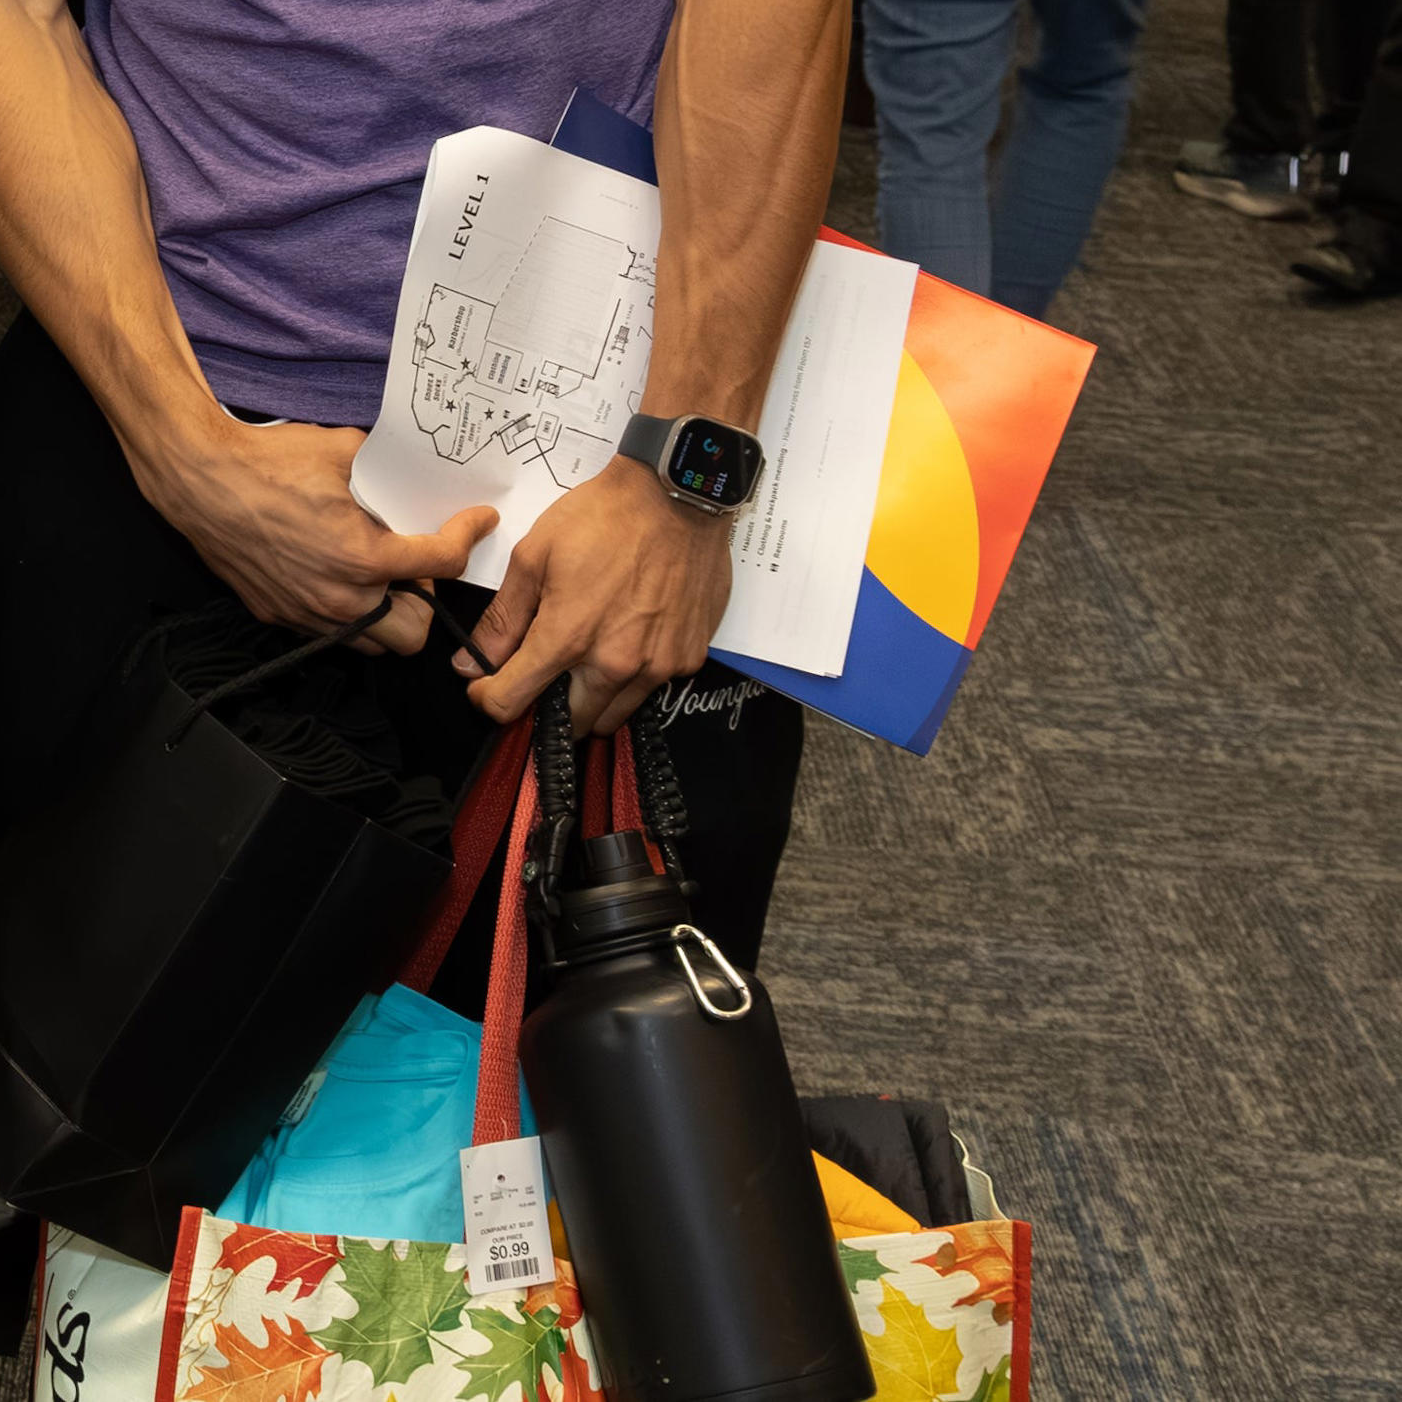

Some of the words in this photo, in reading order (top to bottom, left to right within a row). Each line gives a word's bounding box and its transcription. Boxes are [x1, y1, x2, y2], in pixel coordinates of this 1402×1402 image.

[449, 190, 484, 261] LEVEL
[477, 173, 490, 186] 1
[448, 305, 466, 349] Barbershop
[488, 352, 501, 380] Clothing
[498, 355, 511, 384] mending
[798, 350, 808, 373] Room
[433, 379, 442, 401] Socks
[795, 373, 803, 390] from
[789, 390, 800, 412] across
[775, 448, 788, 480] mending
[711, 472, 728, 497] 11:01
[767, 481, 779, 516] backpack
[743, 521, 755, 551] Haircuts
[757, 523, 771, 555] Clothing
[773, 519, 788, 558] Restrooms
[489, 1241, 530, 1261] $0.99
[492, 1236, 505, 1244] OUR
[506, 1233, 523, 1242] PRICE
